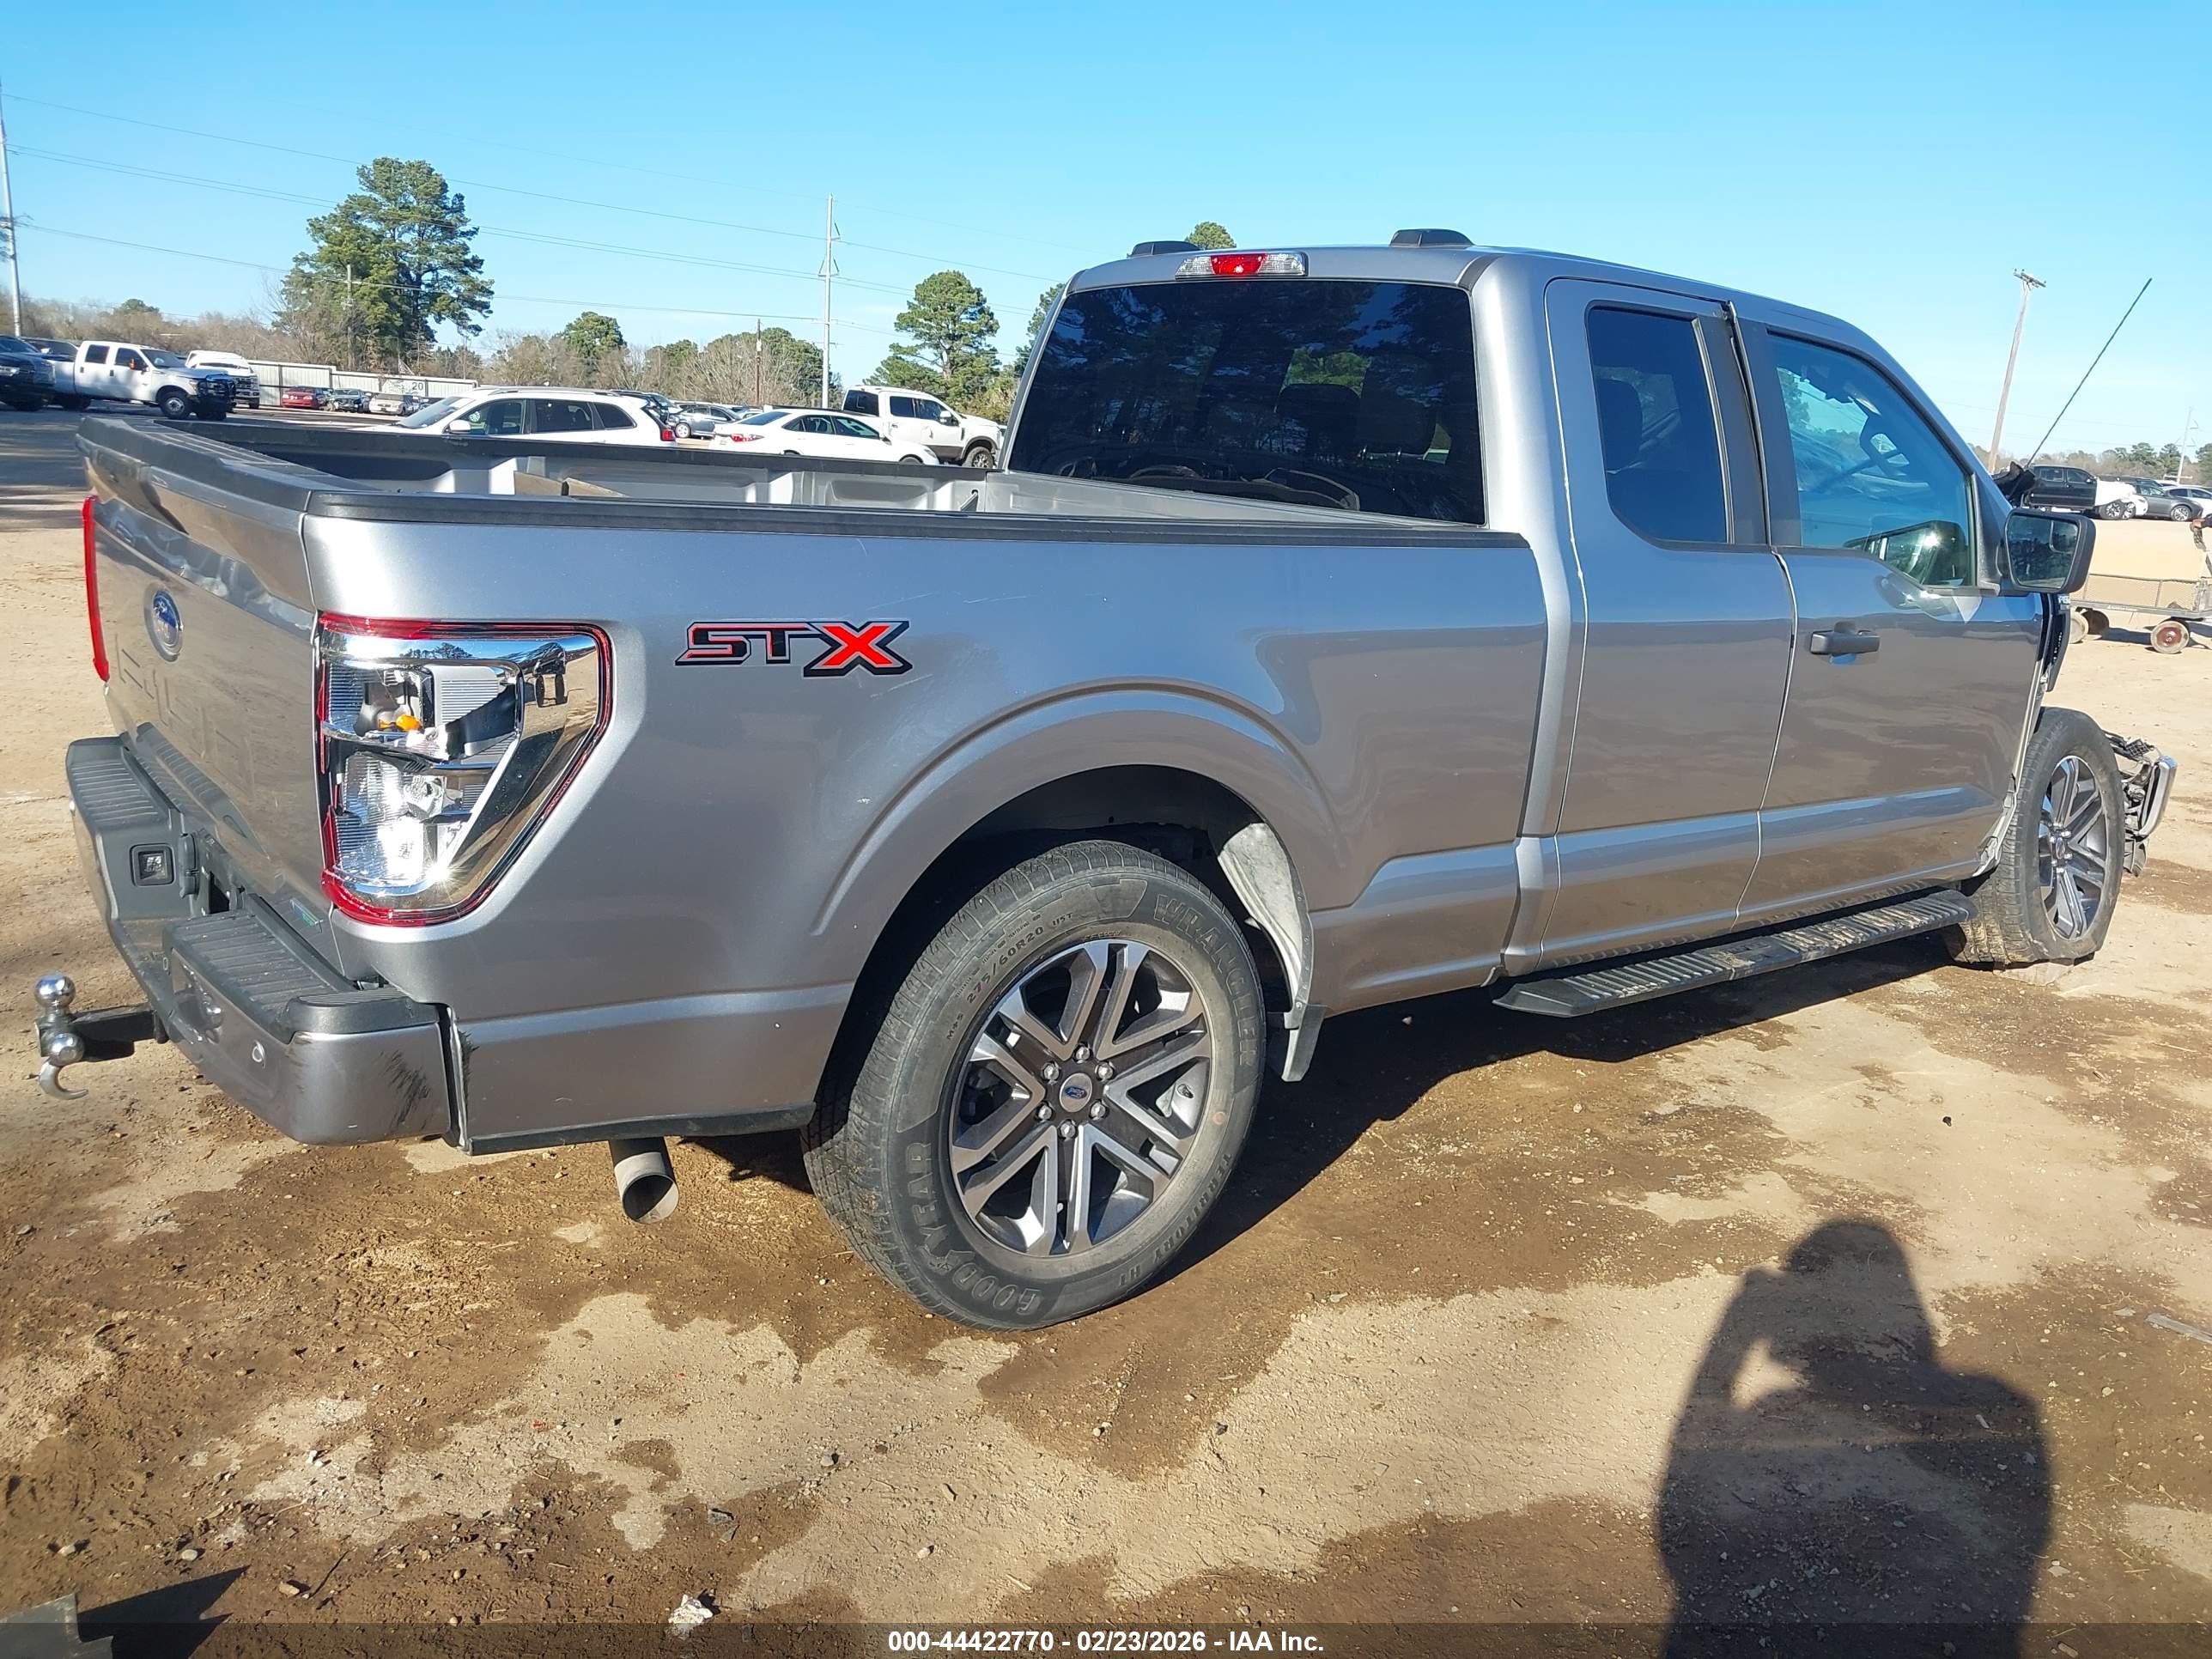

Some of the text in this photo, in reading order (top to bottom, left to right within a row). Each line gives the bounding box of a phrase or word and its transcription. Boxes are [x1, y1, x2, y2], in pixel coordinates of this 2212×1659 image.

[411, 381, 424, 391] 20
[674, 620, 914, 678] STX
[947, 1012, 964, 1041] M+S
[966, 926, 1044, 1004] 275/60R20
[1153, 893, 1260, 1068] WRANGLER
[905, 1142, 1046, 1316] GOODYEAR
[1153, 1152, 1233, 1264] TERRITORY
